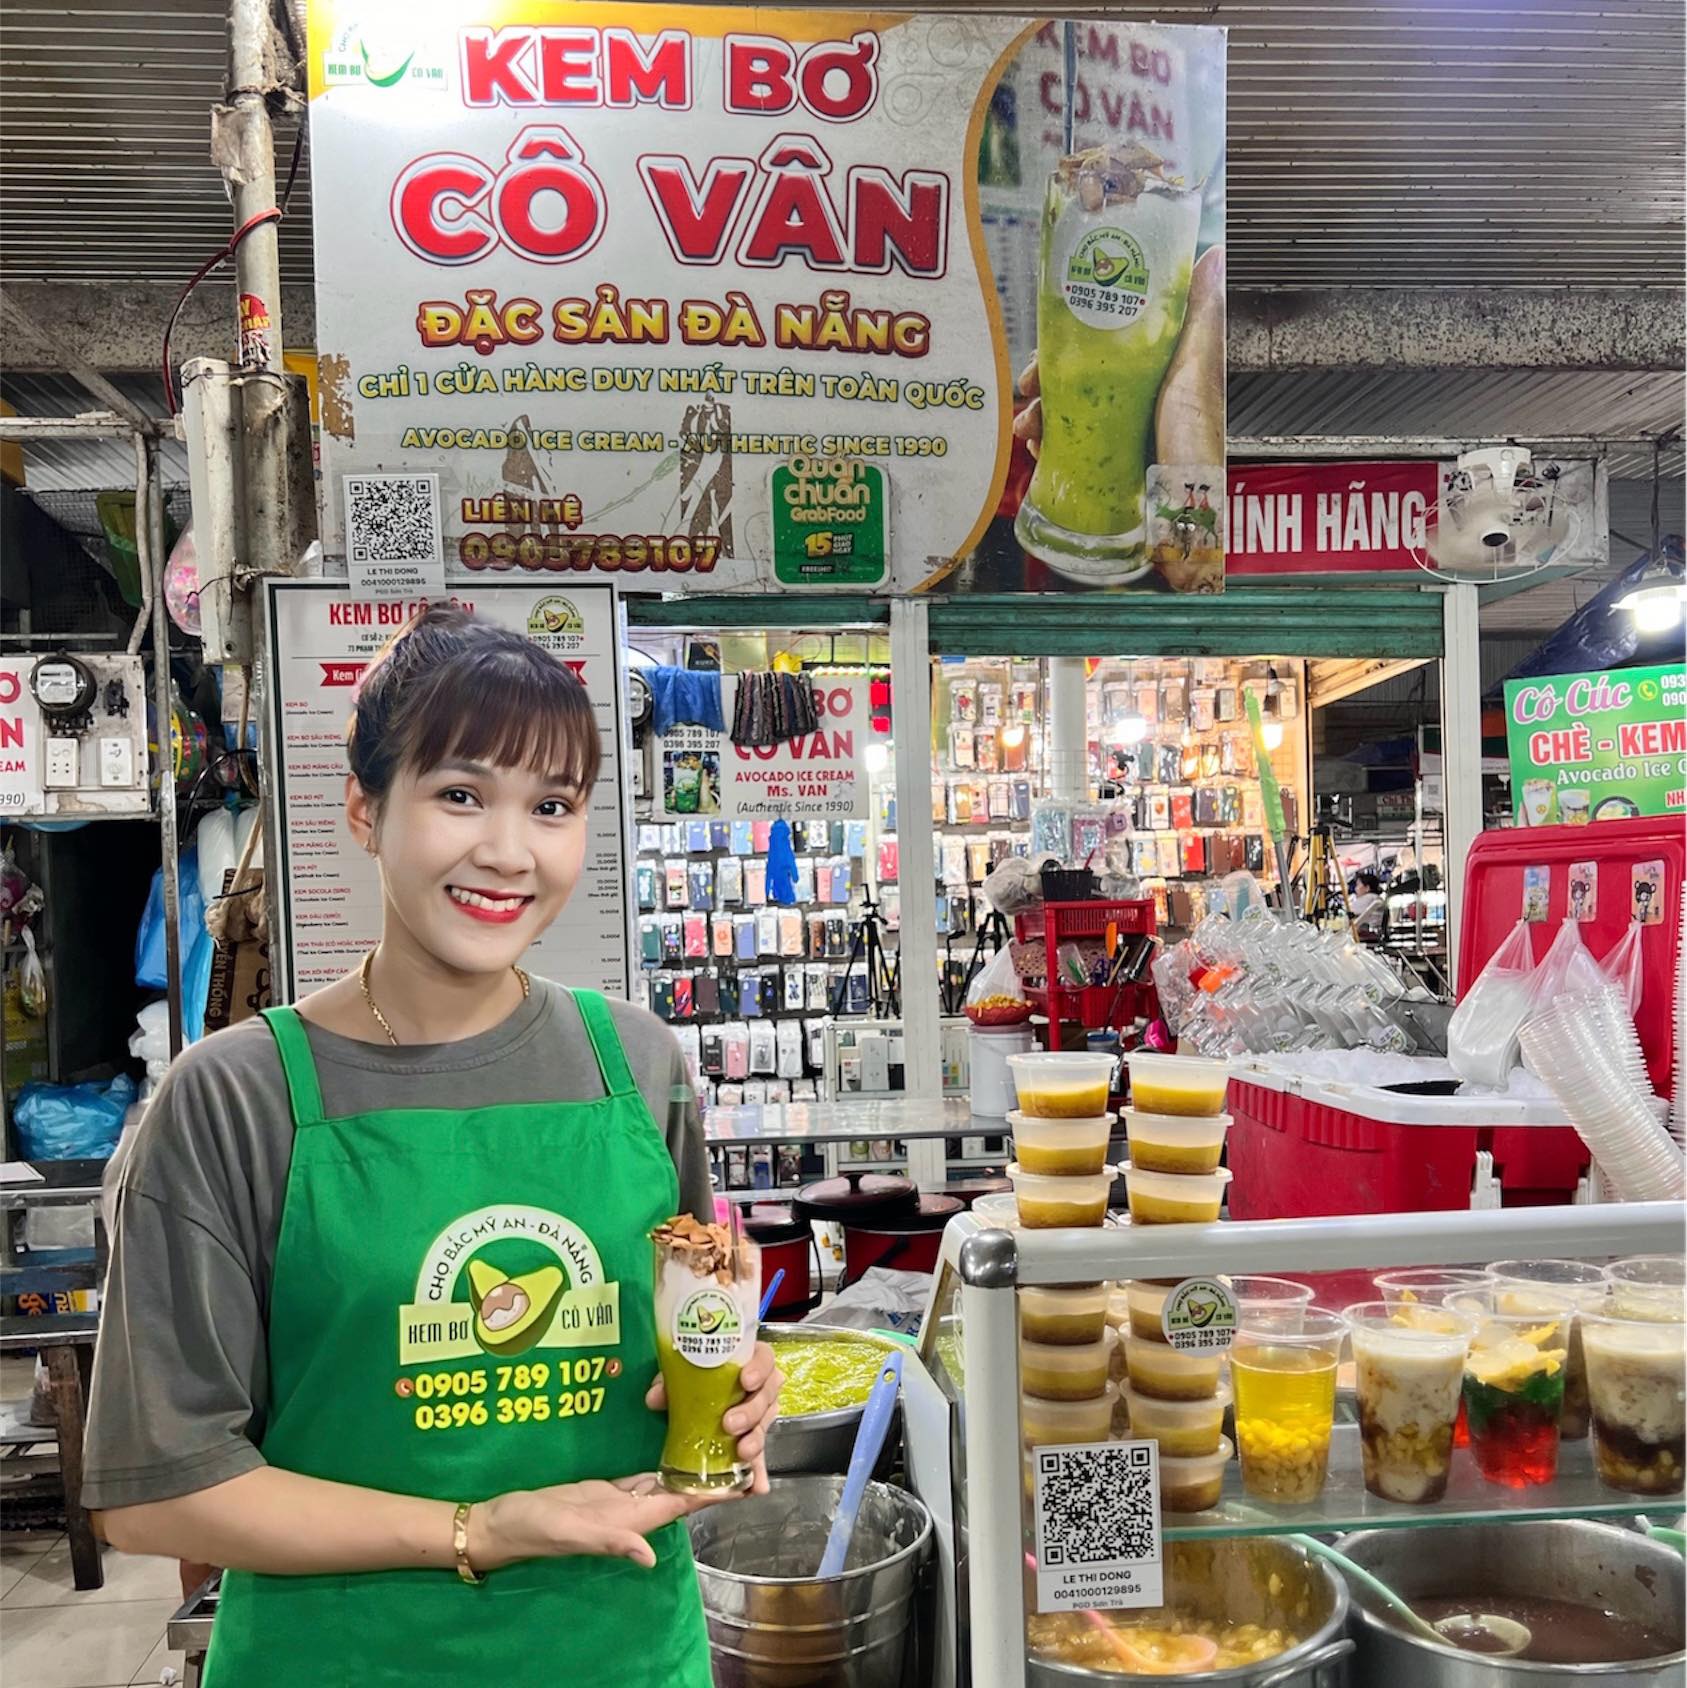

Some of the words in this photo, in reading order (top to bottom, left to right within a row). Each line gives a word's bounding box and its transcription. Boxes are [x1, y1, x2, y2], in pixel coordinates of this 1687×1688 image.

[1035, 20, 1120, 71] KM
[457, 26, 692, 111] KEM
[723, 32, 880, 122] BƠ
[390, 124, 608, 266] CÔ
[636, 133, 949, 279] VÂN
[1071, 284, 1097, 298] 0905
[1099, 290, 1119, 303] 789
[1121, 294, 1140, 306] 107
[1095, 300, 1116, 314] 395
[1118, 305, 1139, 317] 207
[416, 290, 543, 355] ĐẶC
[552, 282, 669, 347] SẢN
[679, 292, 767, 347] ĐÀ
[775, 290, 929, 358] NẴNG
[358, 364, 411, 398] CHỈ
[413, 371, 430, 396] 1
[434, 361, 498, 394] CỬA
[503, 364, 586, 393] HÀNG
[592, 368, 651, 392] DUY
[660, 363, 738, 395] NHẤT
[741, 366, 816, 398] TRÊN
[820, 366, 899, 402] TOÀN
[904, 373, 986, 411] QUỐC
[401, 427, 527, 450] AVOCADO
[531, 429, 573, 452] ICE
[577, 430, 665, 453] CREAM
[820, 434, 893, 457] SINCE
[895, 436, 947, 458] 1990
[461, 493, 532, 524] LIÊN
[540, 494, 583, 530] HỆ
[790, 506, 867, 523] GrabFood
[1316, 480, 1427, 553] HÃNG
[459, 532, 722, 572] 0905789107
[804, 531, 834, 558] 15
[329, 602, 372, 625] KEM
[378, 600, 403, 625] BƠ
[333, 669, 355, 682] Kem
[1513, 683, 1564, 724] Cô
[1565, 675, 1634, 718] Cúc
[663, 739, 685, 749] 0396
[686, 739, 703, 749] 395
[704, 739, 721, 749] 207
[1529, 721, 1593, 766] CHÈ
[1618, 720, 1687, 759] KEM
[735, 771, 795, 782] AVOCADO
[797, 771, 815, 782] ICE
[816, 770, 855, 782] CREAM
[1556, 762, 1637, 786] Avocado
[1643, 761, 1672, 778] Ice
[767, 785, 794, 798] Ms.
[798, 784, 828, 797] VAN
[736, 801, 793, 815] (Authentic
[795, 800, 823, 813] Since
[824, 800, 855, 814] 1990)
[210, 972, 228, 1018] THỐNG
[429, 1262, 453, 1301] CHỢ
[445, 1231, 473, 1261] BẮC
[473, 1216, 497, 1238] MỸ
[503, 1217, 526, 1230] AN
[561, 1237, 594, 1284] NẴNG
[408, 1322, 442, 1345] KEM
[448, 1318, 470, 1341] BƠ
[586, 1301, 614, 1327] VÂN
[1216, 1328, 1231, 1337] 107
[1216, 1337, 1232, 1346] 207
[414, 1373, 488, 1399] 0905
[496, 1363, 550, 1392] 789
[558, 1357, 606, 1386] 107
[415, 1402, 489, 1430] 0396
[496, 1394, 551, 1423] 395
[558, 1387, 606, 1418] 207
[1054, 1584, 1142, 1600] 0041000129895
[1063, 1574, 1077, 1584] LE
[1079, 1573, 1098, 1583] THI
[1099, 1570, 1132, 1581] DONG
